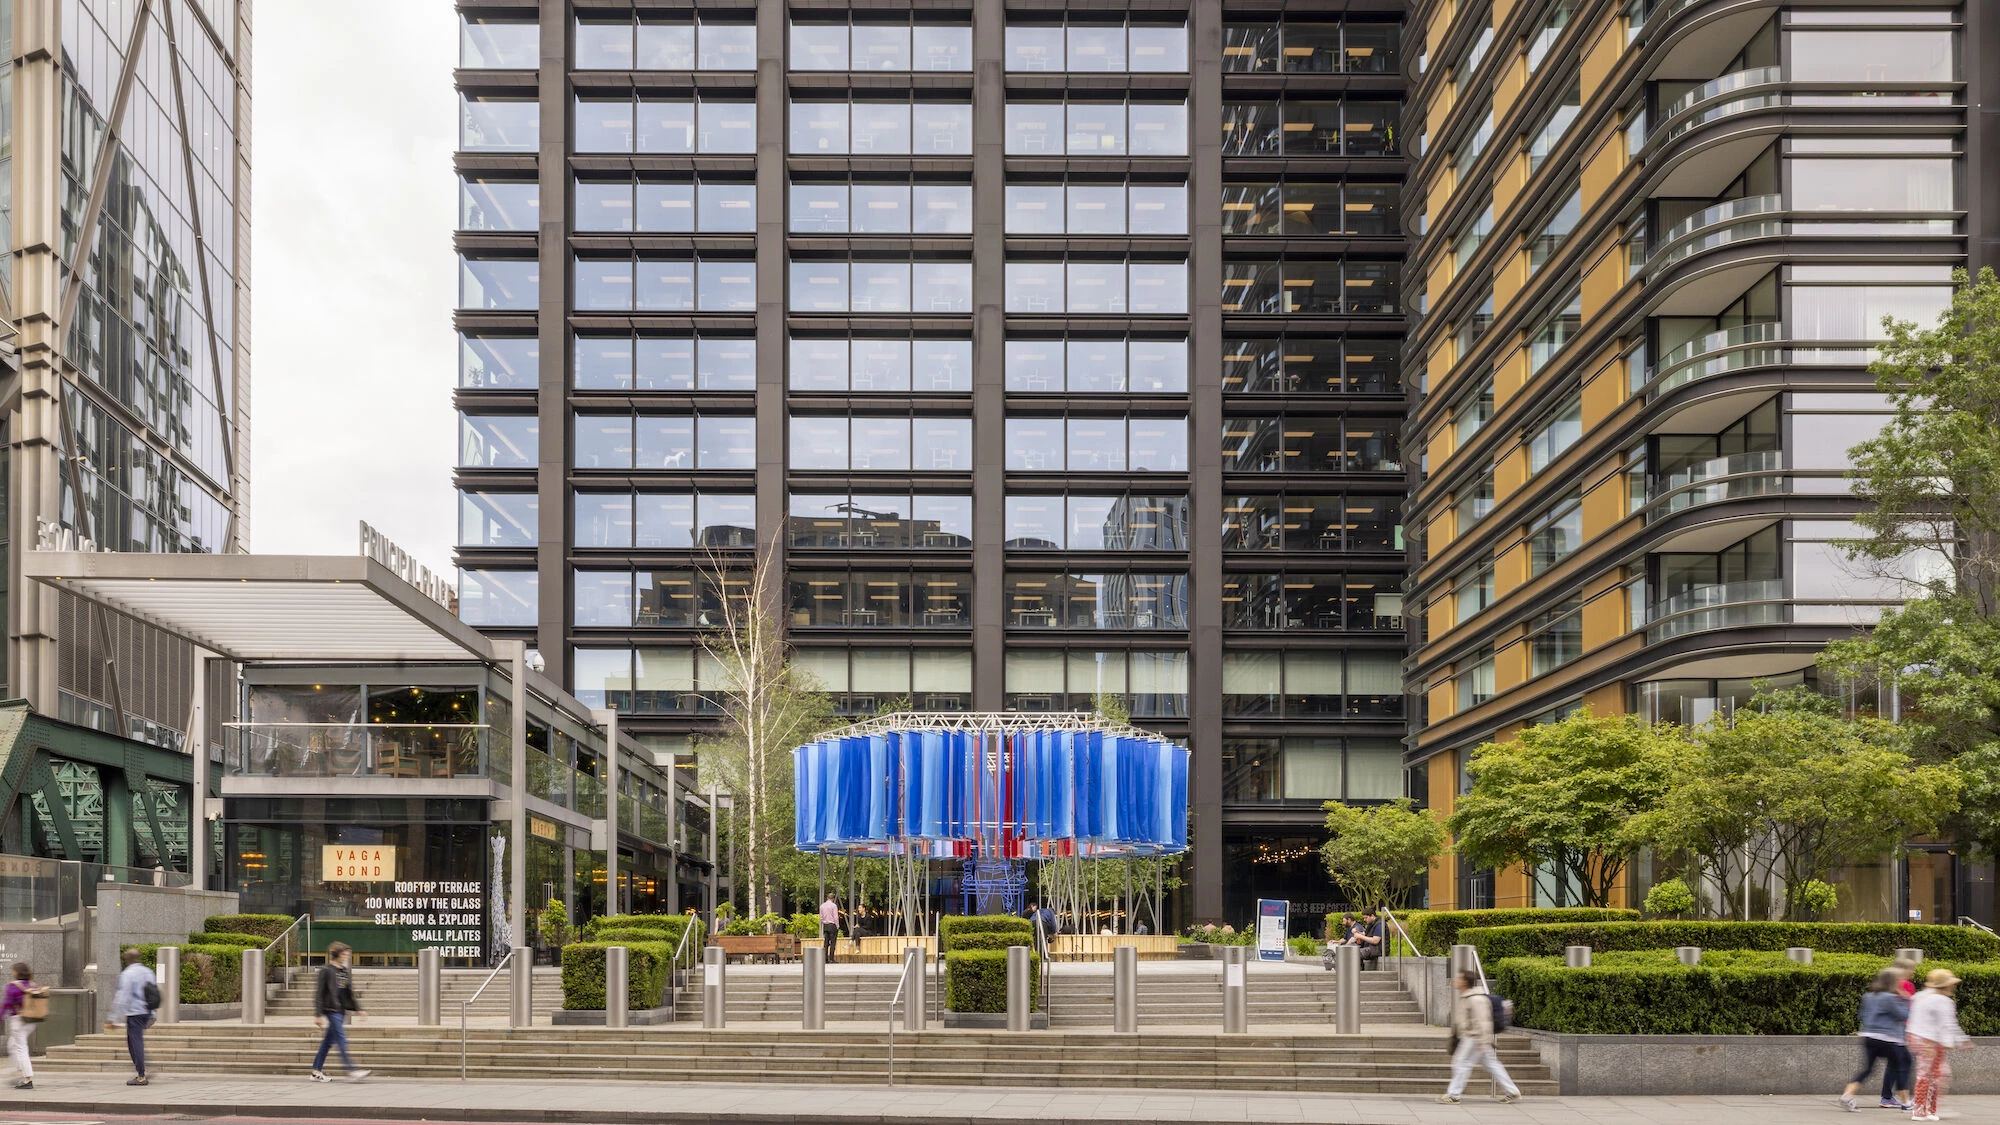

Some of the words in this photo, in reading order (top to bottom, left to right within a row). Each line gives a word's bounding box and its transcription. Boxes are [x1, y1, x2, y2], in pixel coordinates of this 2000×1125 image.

[360, 520, 416, 588] PRINCIPAL
[336, 850, 381, 861] VAGA
[336, 865, 381, 877] BOND
[394, 881, 437, 893] ROOFTOP
[439, 881, 481, 893] TERRACE
[364, 897, 382, 909] 100
[384, 897, 414, 909] WINES
[416, 897, 429, 909] BY
[431, 897, 448, 909] THE
[450, 897, 481, 909] GLASS
[374, 913, 398, 925] SELF
[400, 913, 425, 925] POUR
[427, 914, 437, 926] &
[439, 913, 481, 925] EXPLORE
[411, 930, 444, 941] SMALL
[446, 930, 481, 941] PLATES
[457, 946, 481, 958] BEER
